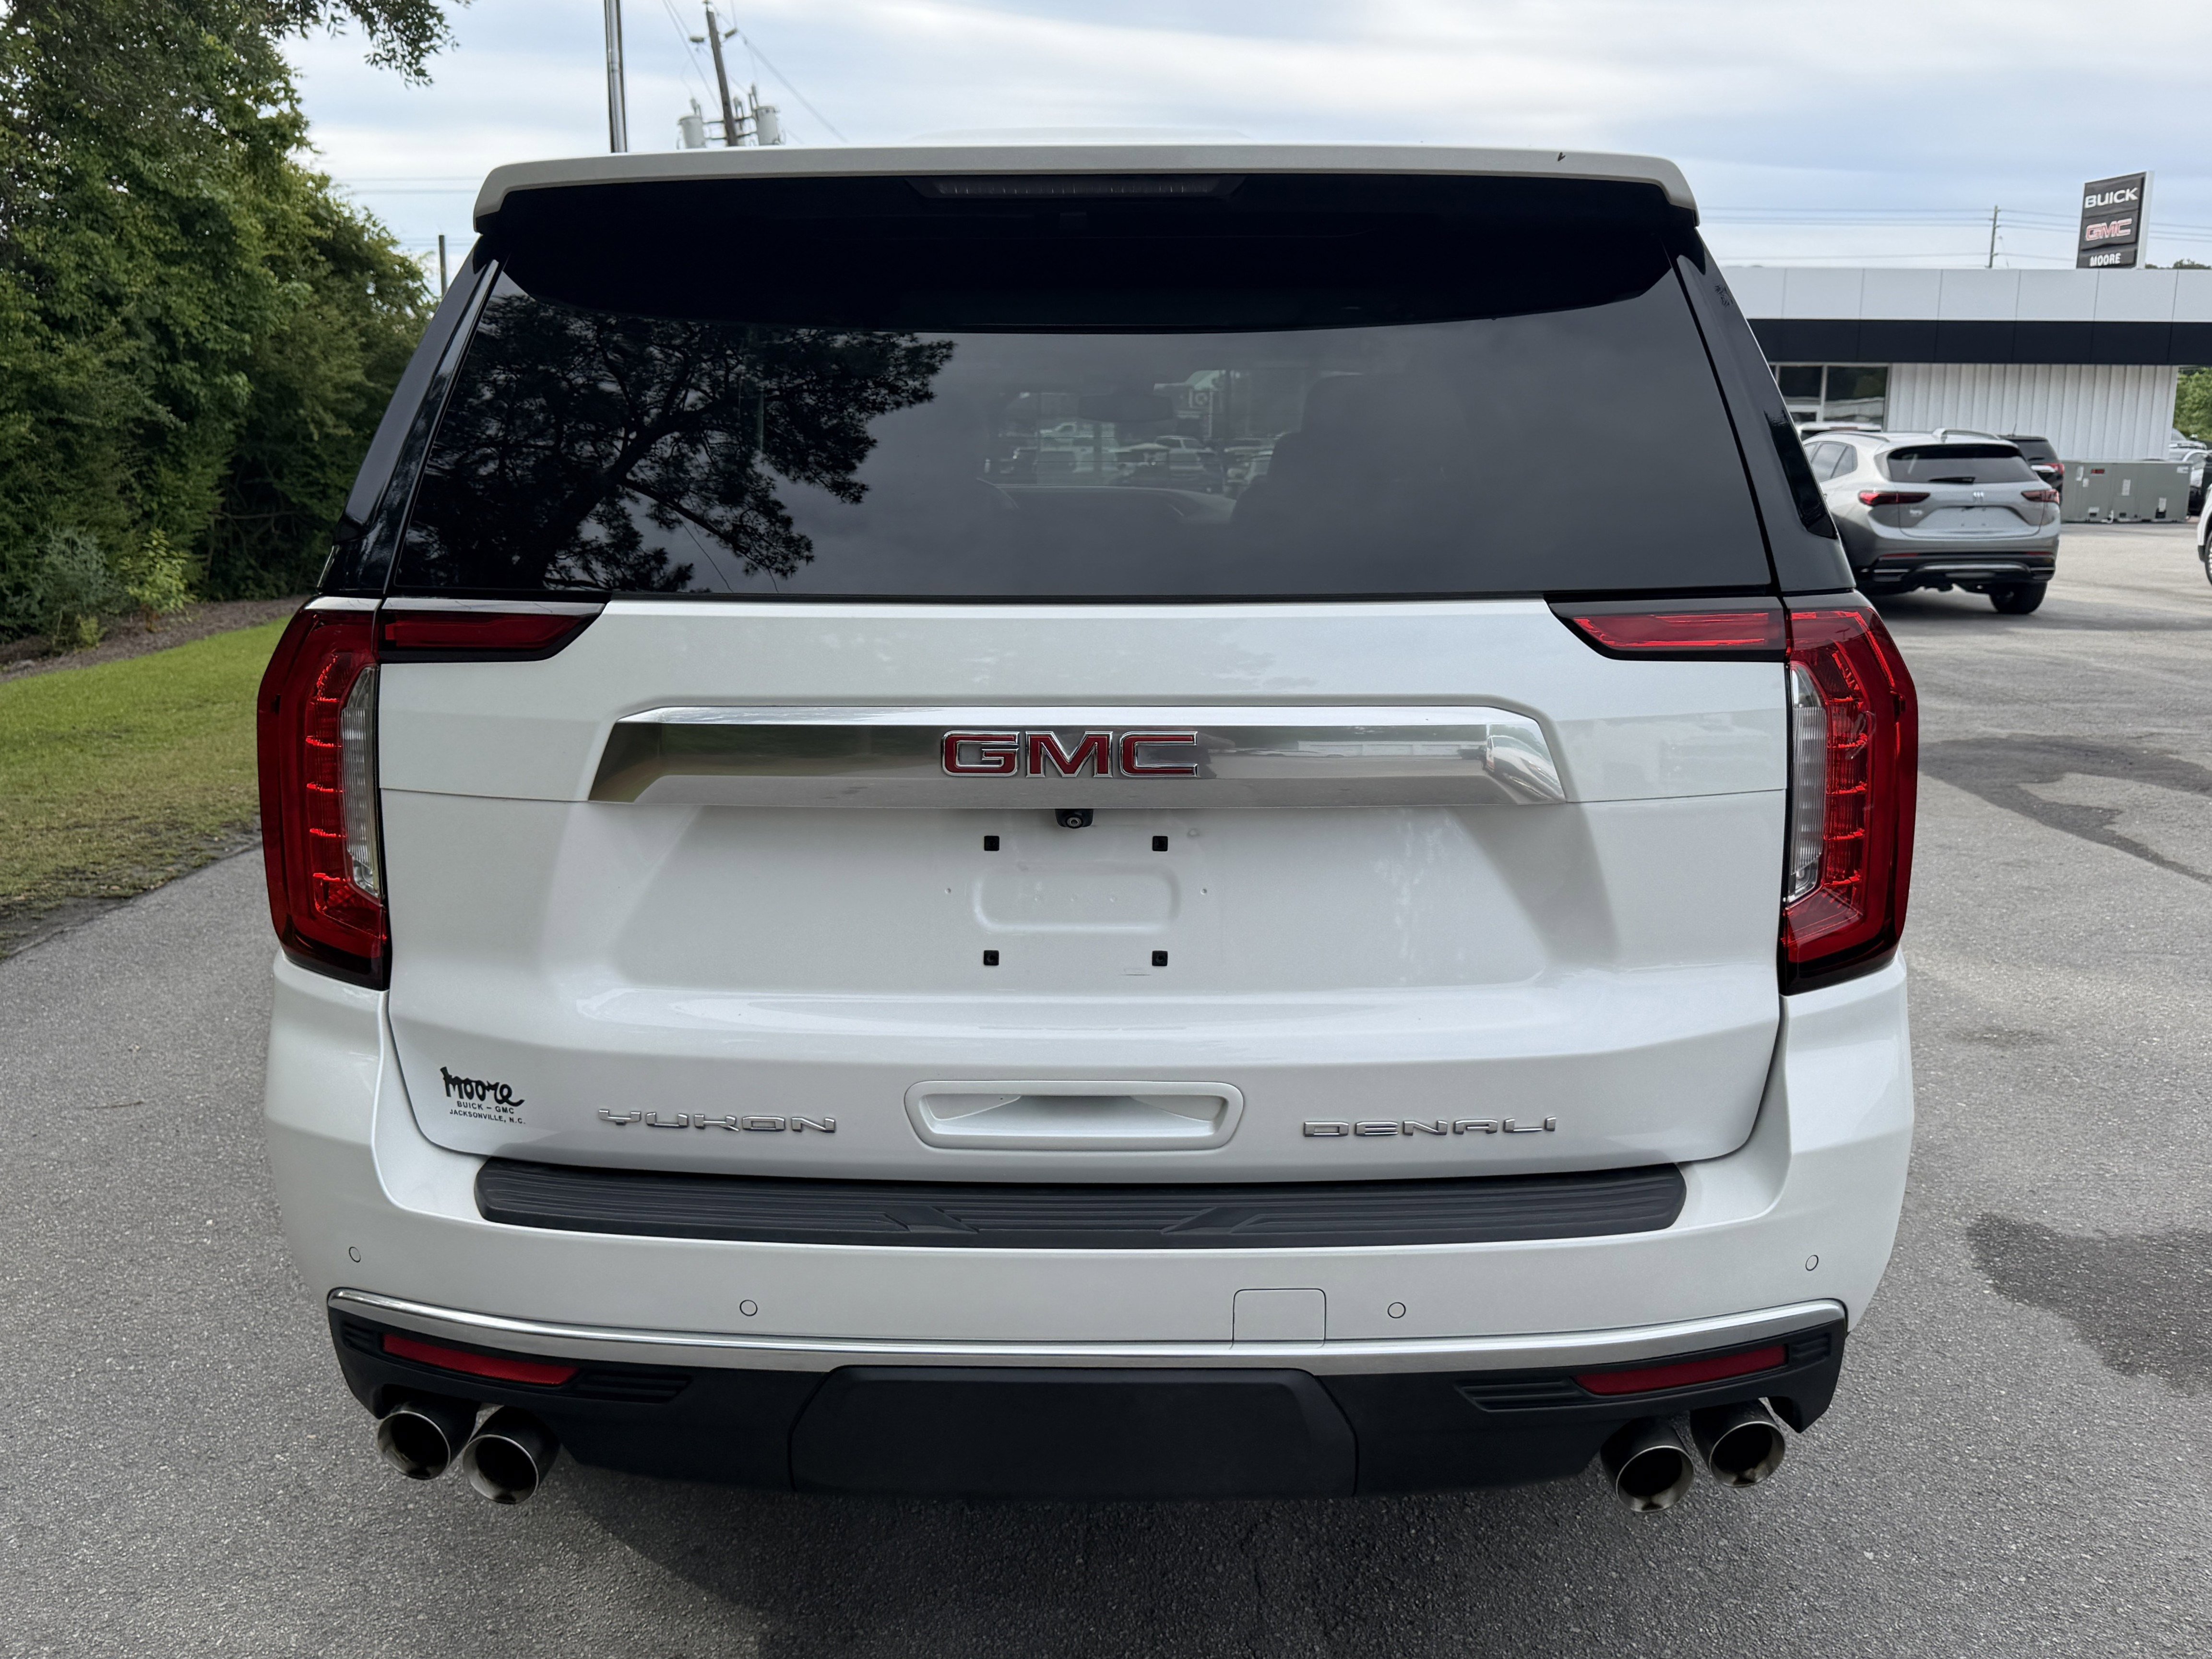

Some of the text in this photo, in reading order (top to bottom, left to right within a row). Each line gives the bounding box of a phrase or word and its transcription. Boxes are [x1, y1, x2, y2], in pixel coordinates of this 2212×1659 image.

[2084, 187, 2138, 208] BUICK
[2085, 218, 2132, 241] GMC
[2089, 252, 2121, 267] MOORE
[941, 730, 1199, 778] GMC
[450, 1110, 506, 1122] JACKSONVILLE,
[457, 1101, 483, 1110] BUICK
[495, 1106, 514, 1114] GMC
[599, 1109, 836, 1133] YUKON
[1304, 1117, 1557, 1137] DENALI
